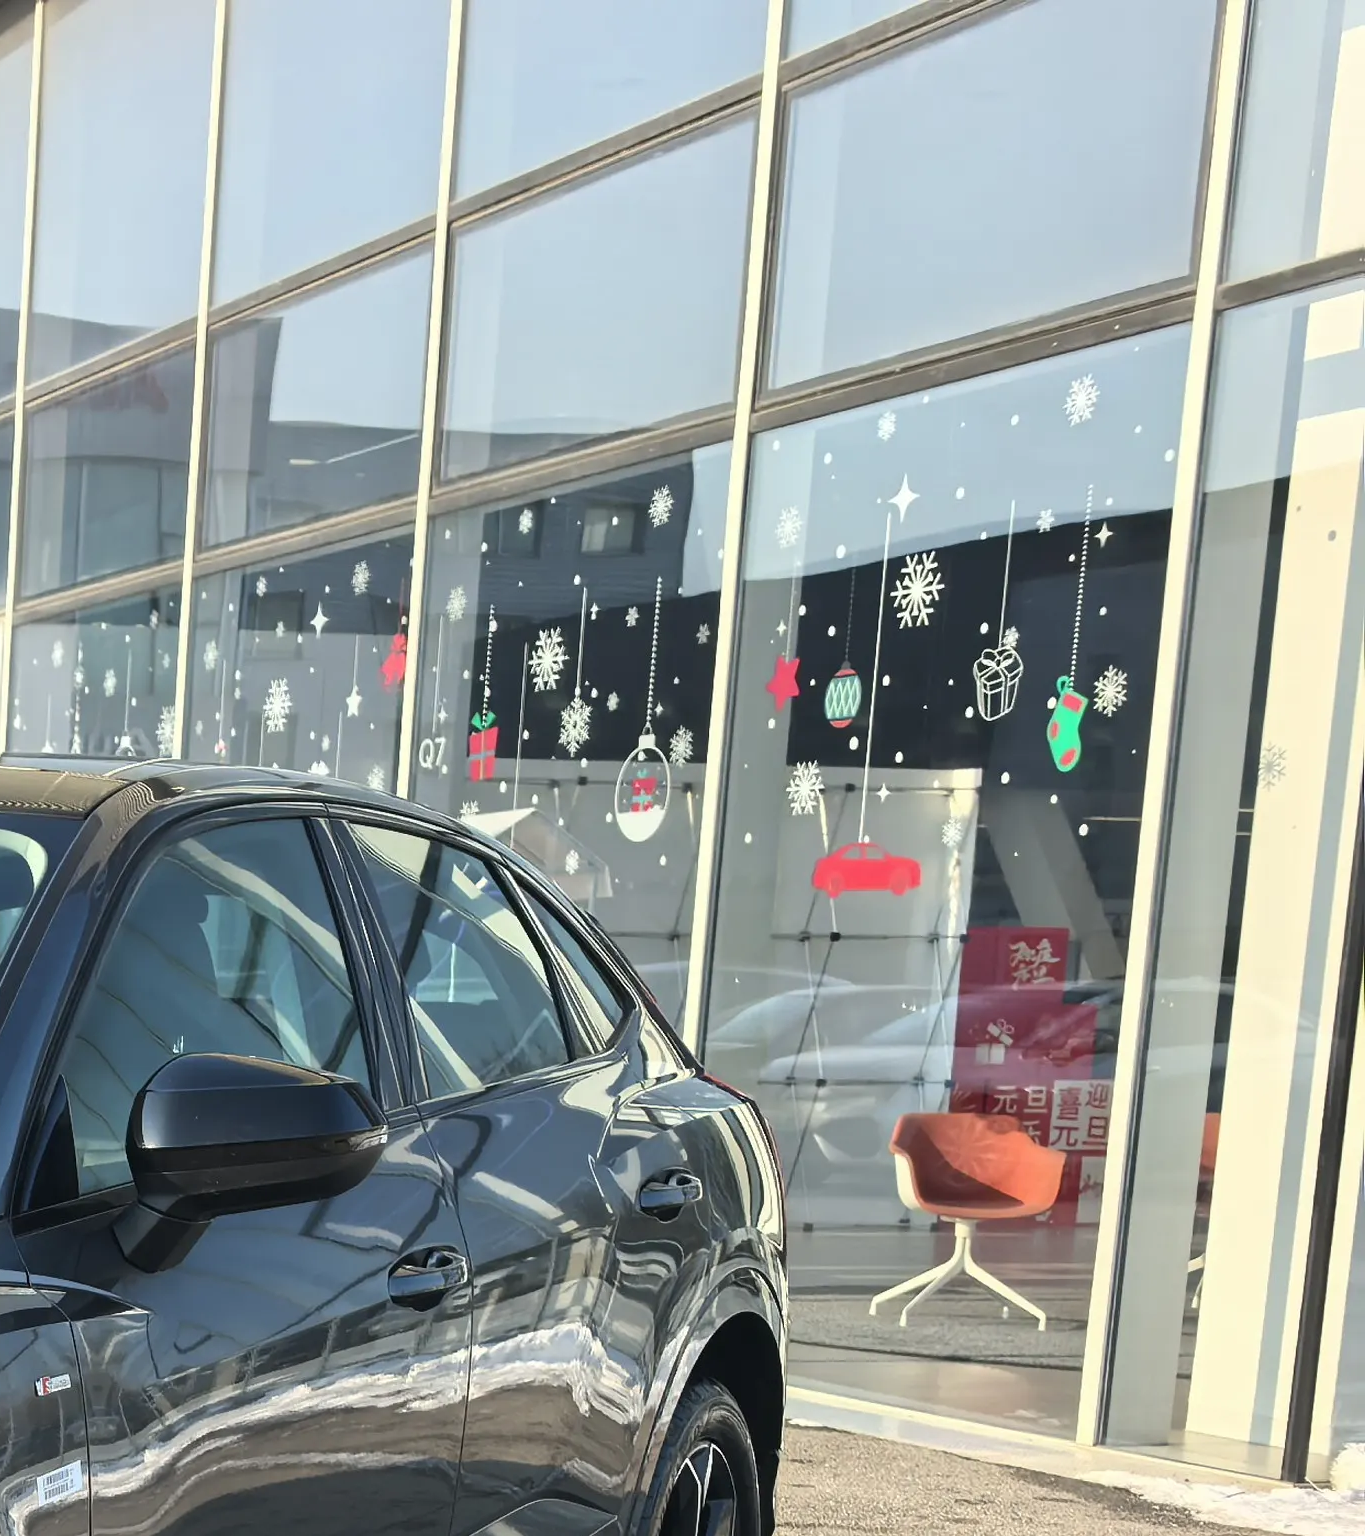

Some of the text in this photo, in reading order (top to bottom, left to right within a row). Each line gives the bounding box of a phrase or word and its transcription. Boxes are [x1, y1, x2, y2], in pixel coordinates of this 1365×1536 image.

[418, 737, 446, 769] Q7
[992, 1085, 1047, 1113] 元旦
[1057, 1082, 1108, 1121] 喜迎
[1050, 1116, 1108, 1147] 元旦
